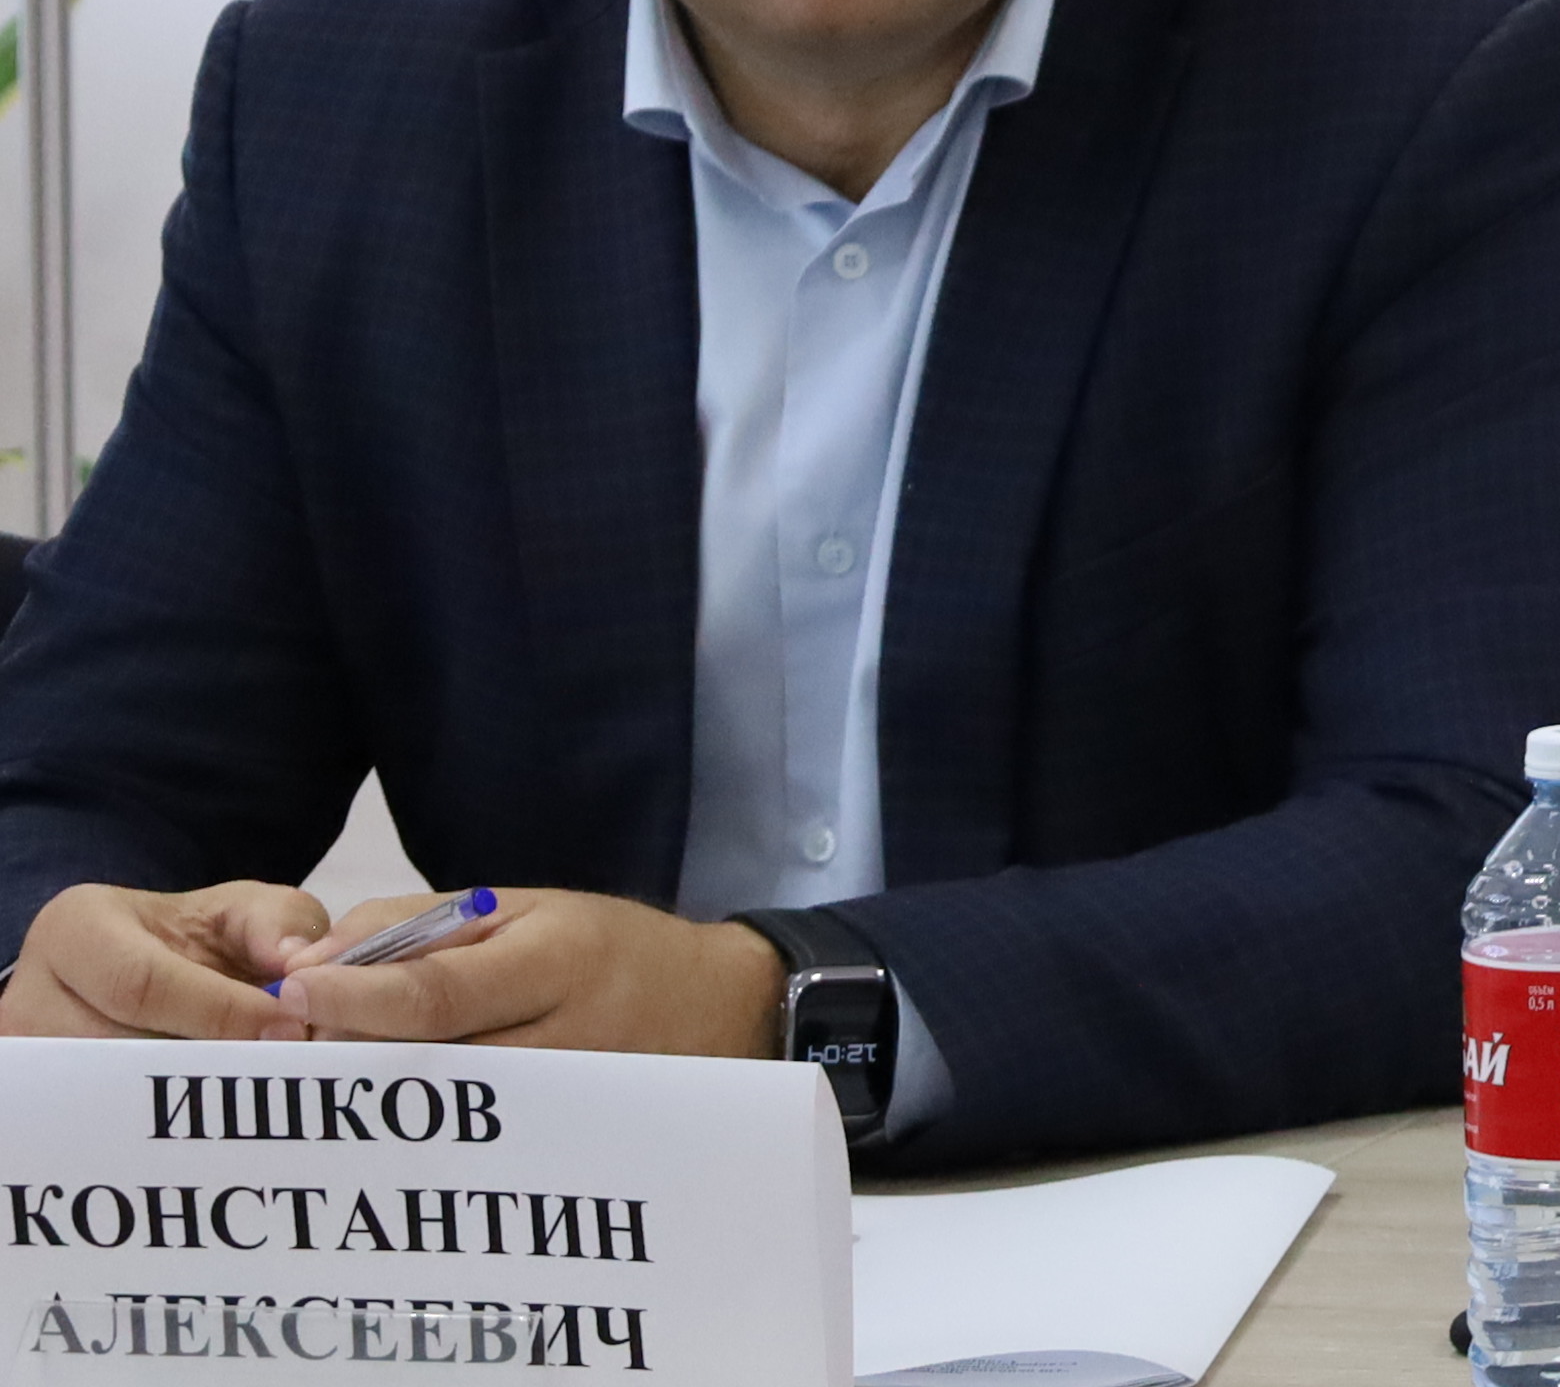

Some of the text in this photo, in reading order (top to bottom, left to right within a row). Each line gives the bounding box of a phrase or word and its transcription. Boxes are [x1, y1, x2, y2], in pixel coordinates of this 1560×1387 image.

[1527, 997, 1545, 1011] 0,5
[1462, 1031, 1512, 1086] АЙ
[144, 1074, 503, 1144] ИШКОВ
[2, 1182, 655, 1263] КОНСТАНТИН
[28, 1291, 654, 1371] АЛЕКСЕЕВИЧ
